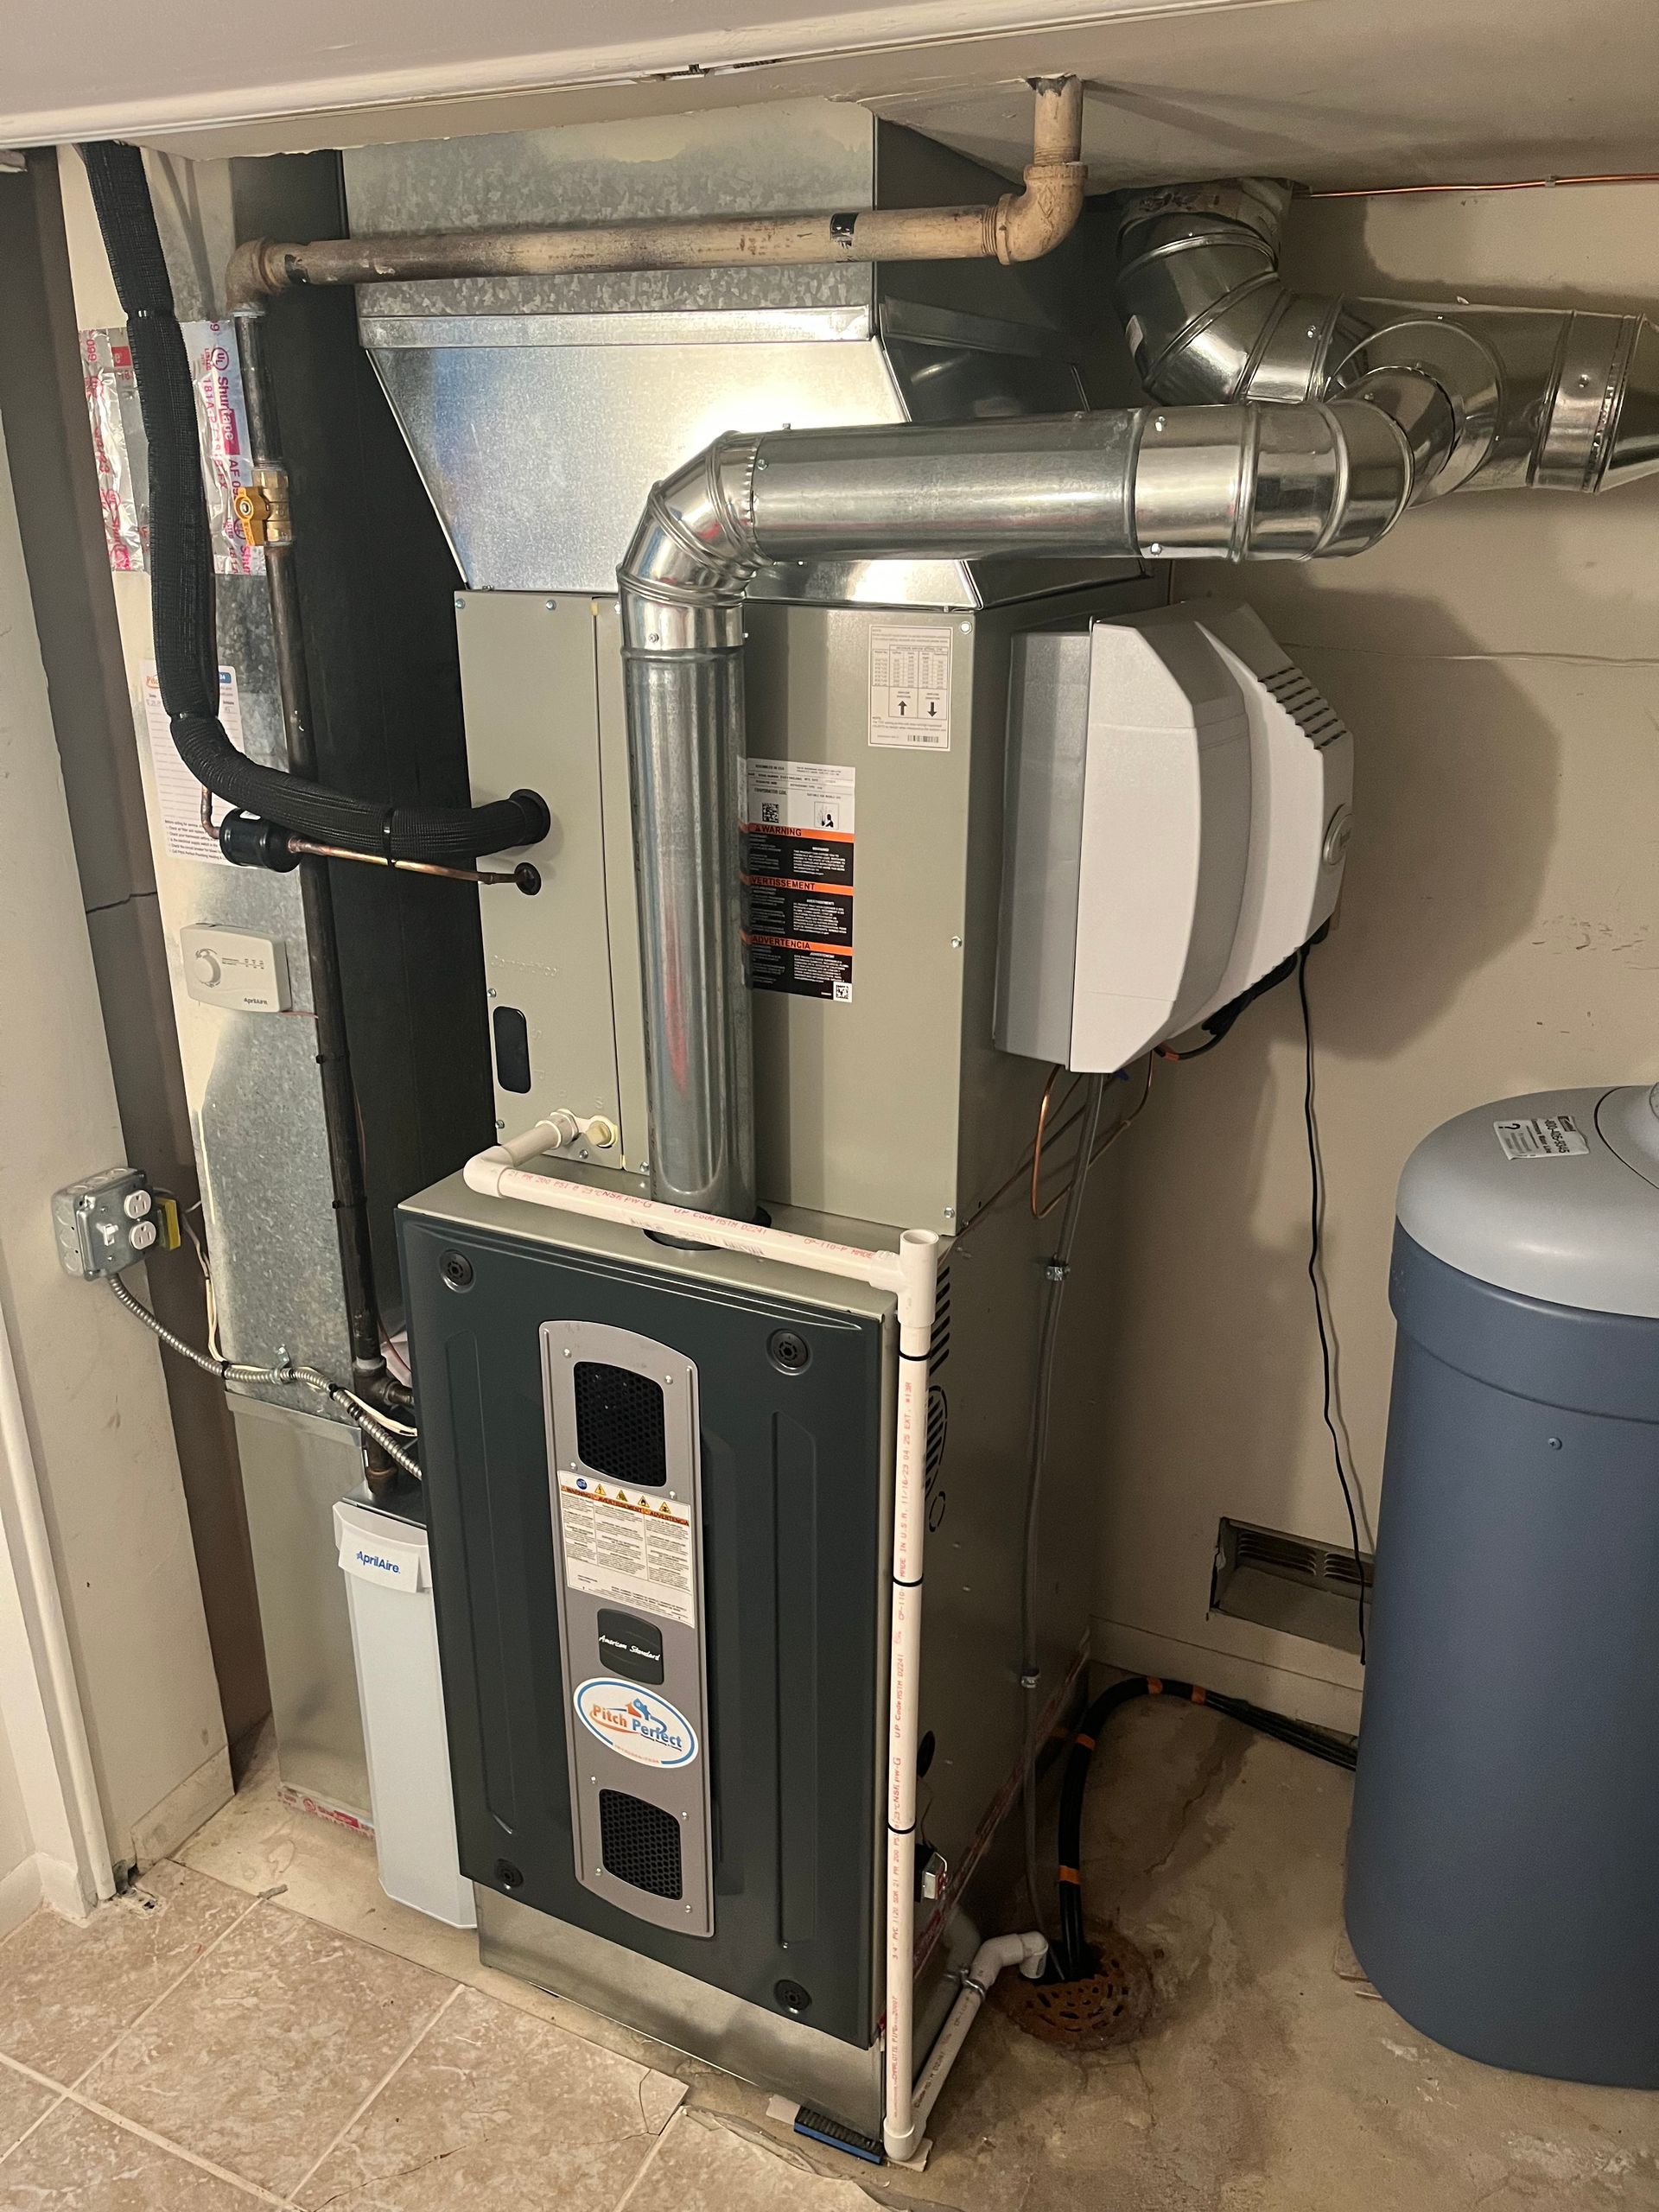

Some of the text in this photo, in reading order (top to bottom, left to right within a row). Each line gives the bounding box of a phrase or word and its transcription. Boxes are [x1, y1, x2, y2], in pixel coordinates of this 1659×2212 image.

[217, 376, 234, 442] Shurtape
[228, 459, 240, 482] AF
[761, 826, 802, 836] WARNING
[752, 876, 816, 891] VERTISSEMENT
[753, 935, 810, 950] ADVERTENCIA
[356, 1551, 400, 1573] AprilAire
[599, 1635, 660, 1661] American Standard
[593, 1704, 627, 1728] Pitch
[632, 1719, 682, 1748] Perfect
